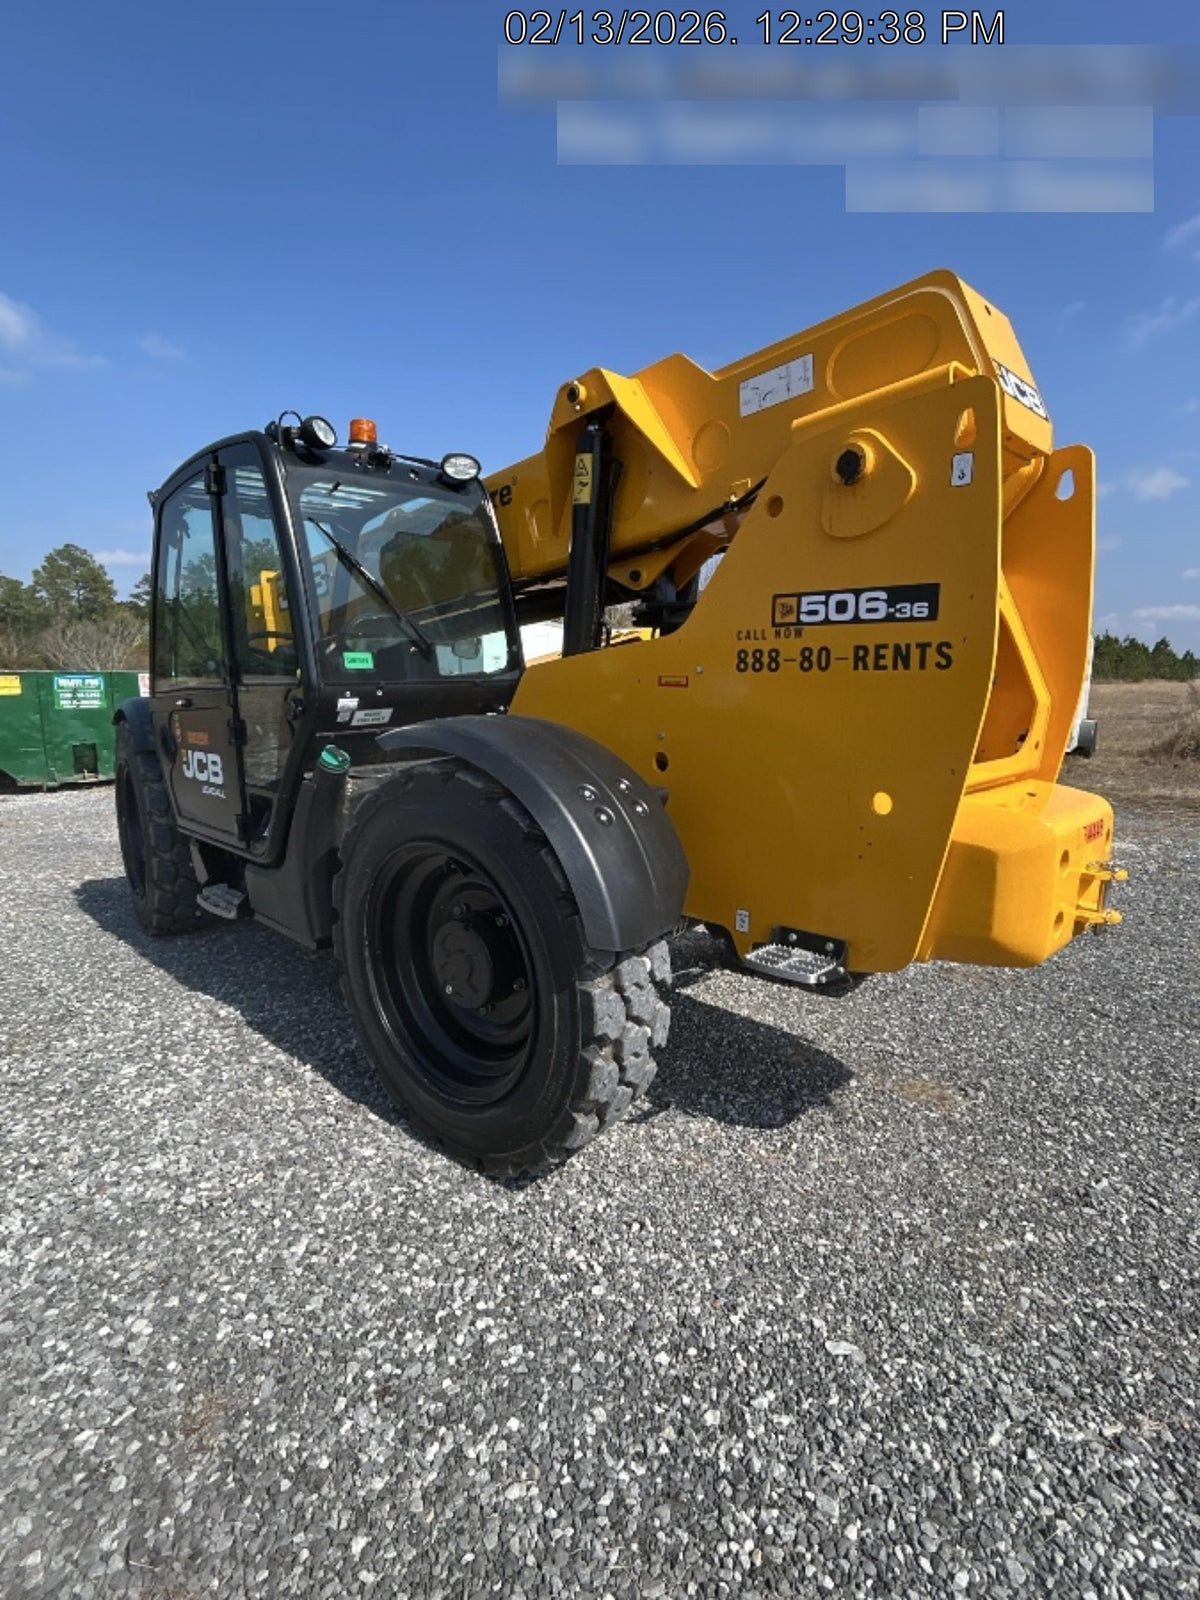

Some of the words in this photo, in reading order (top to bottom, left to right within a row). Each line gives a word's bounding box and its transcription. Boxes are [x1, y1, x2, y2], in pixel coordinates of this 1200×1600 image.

[800, 590, 930, 623] 506-36
[736, 629, 768, 641] CALL
[774, 627, 805, 640] NOW
[735, 641, 954, 673] 888-80-RENTS
[182, 749, 225, 785] JCB
